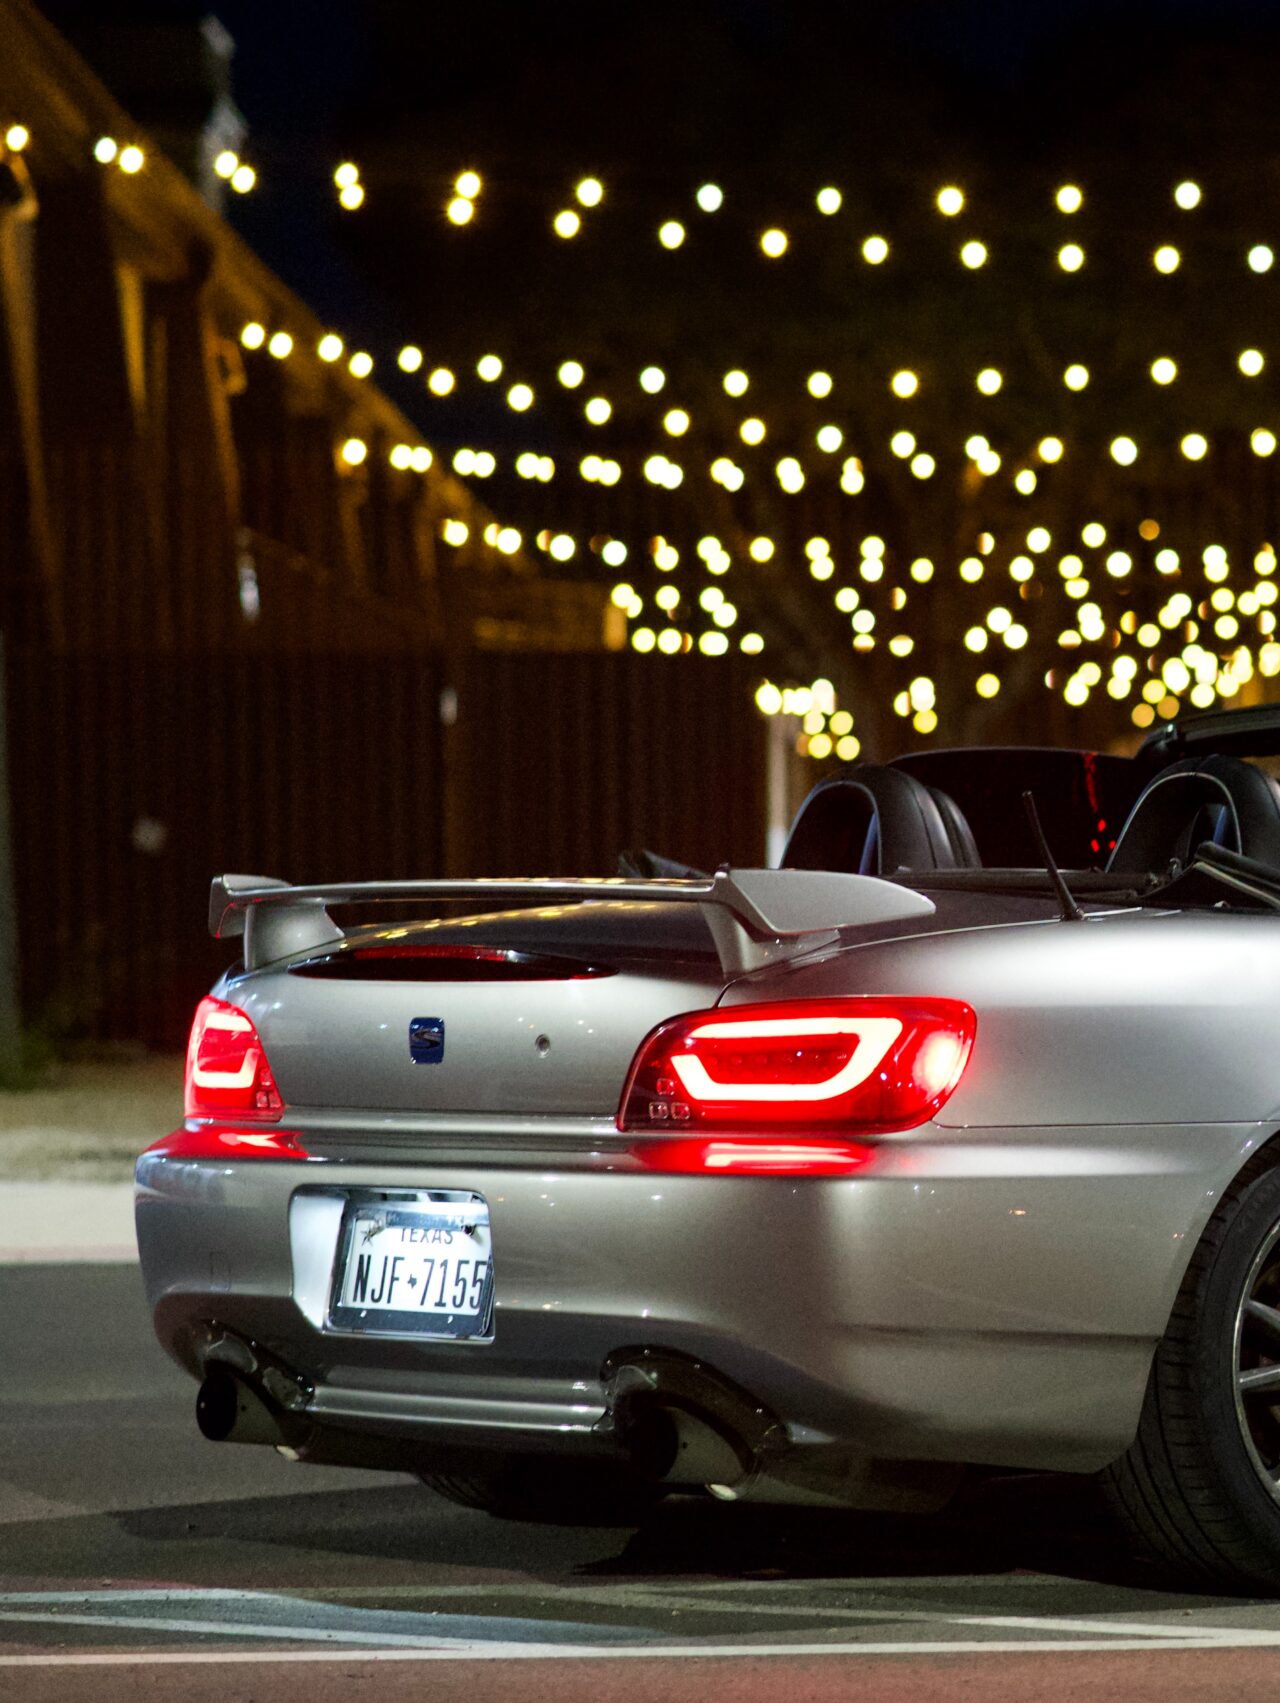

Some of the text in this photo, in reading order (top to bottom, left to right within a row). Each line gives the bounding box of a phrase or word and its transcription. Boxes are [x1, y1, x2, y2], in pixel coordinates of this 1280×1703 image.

[400, 1227, 454, 1245] TEXAS
[352, 1253, 488, 1309] NJF 7155
